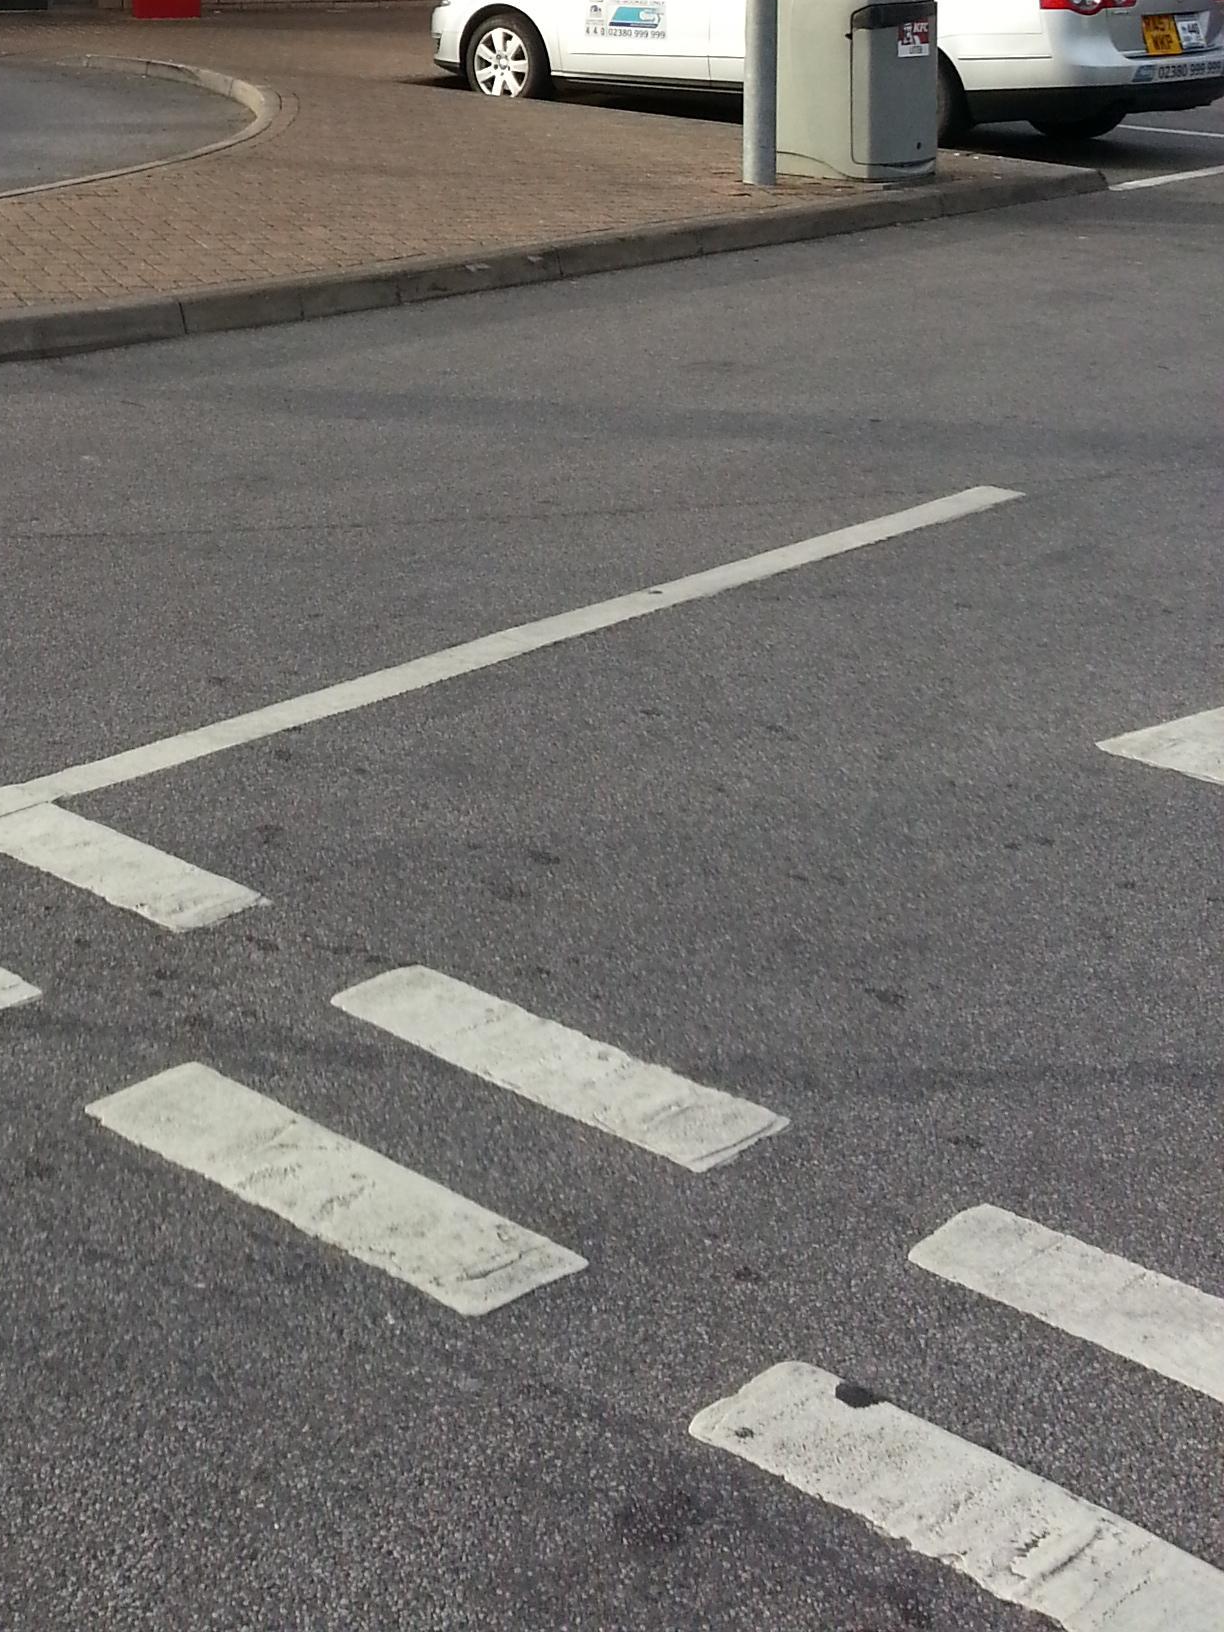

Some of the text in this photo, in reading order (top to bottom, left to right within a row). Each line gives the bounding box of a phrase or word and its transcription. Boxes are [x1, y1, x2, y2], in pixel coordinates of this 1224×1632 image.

[608, 28, 632, 37] 02380
[913, 22, 929, 33] KFC
[1158, 63, 1188, 79] 02380
